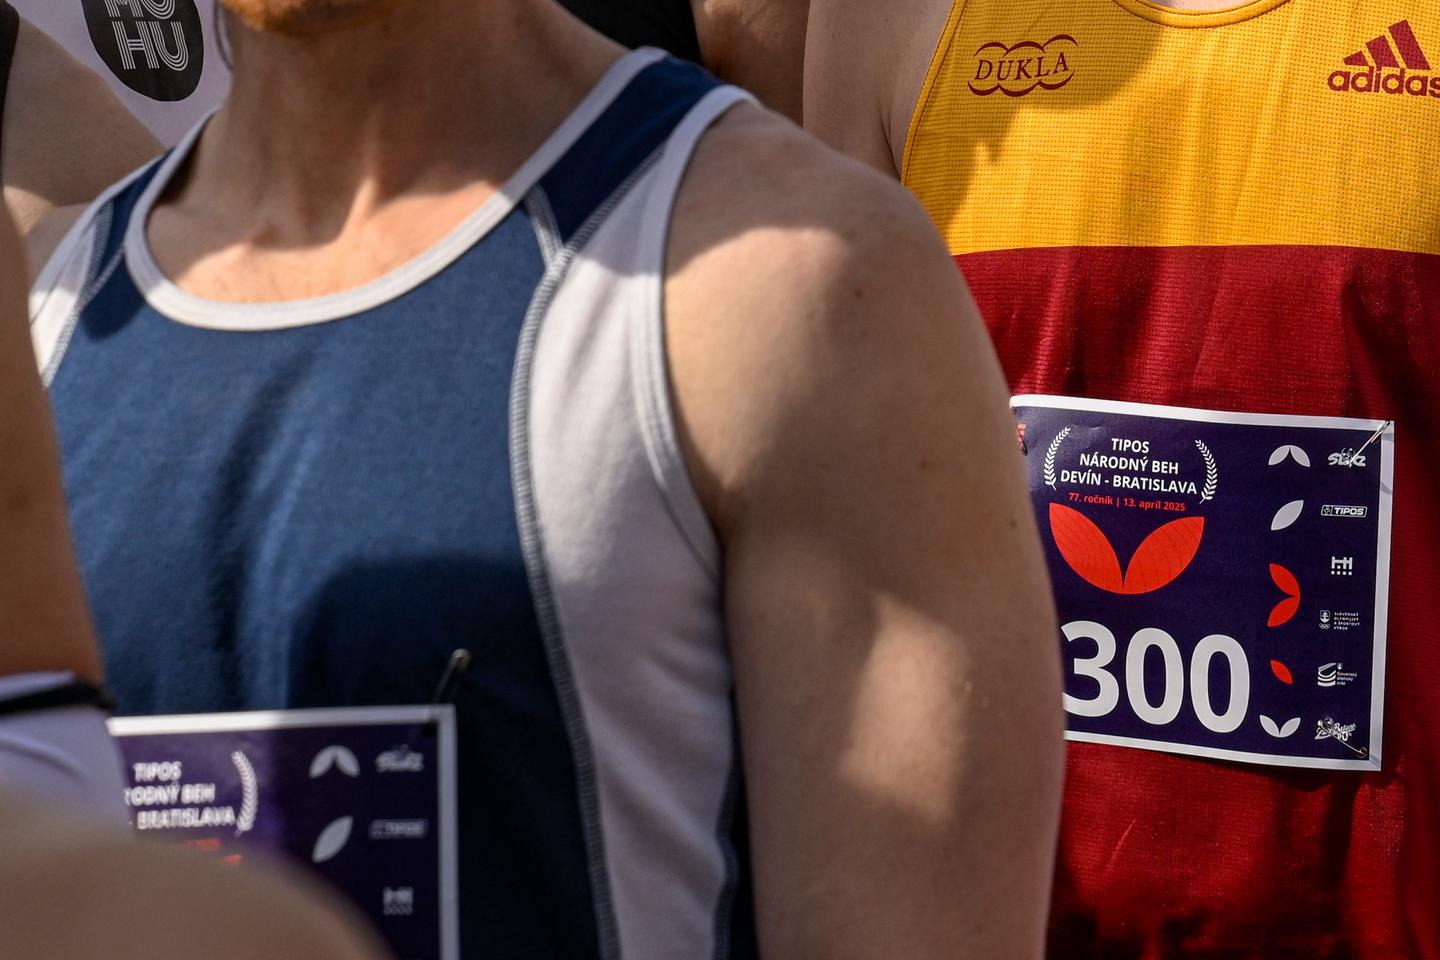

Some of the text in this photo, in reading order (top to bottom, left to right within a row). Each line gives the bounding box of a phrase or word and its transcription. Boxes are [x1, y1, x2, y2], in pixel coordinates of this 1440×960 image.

[111, 20, 189, 71] HU
[973, 51, 1070, 81] DUKLA
[1111, 438, 1150, 454] TIPOS
[1079, 452, 1179, 475] NÁRODNÝ BEH
[1060, 469, 1102, 486] DEVÍN
[1112, 474, 1198, 495] BRATISLAVA
[1068, 492, 1082, 503] 77.
[1083, 494, 1113, 506] ročník
[1123, 498, 1137, 508] 13.
[1163, 501, 1186, 512] 2025
[1334, 507, 1365, 516] TIPOS
[1061, 620, 1250, 733] 300
[133, 761, 182, 782] TIPOS
[137, 806, 236, 830] BRATISLAVA
